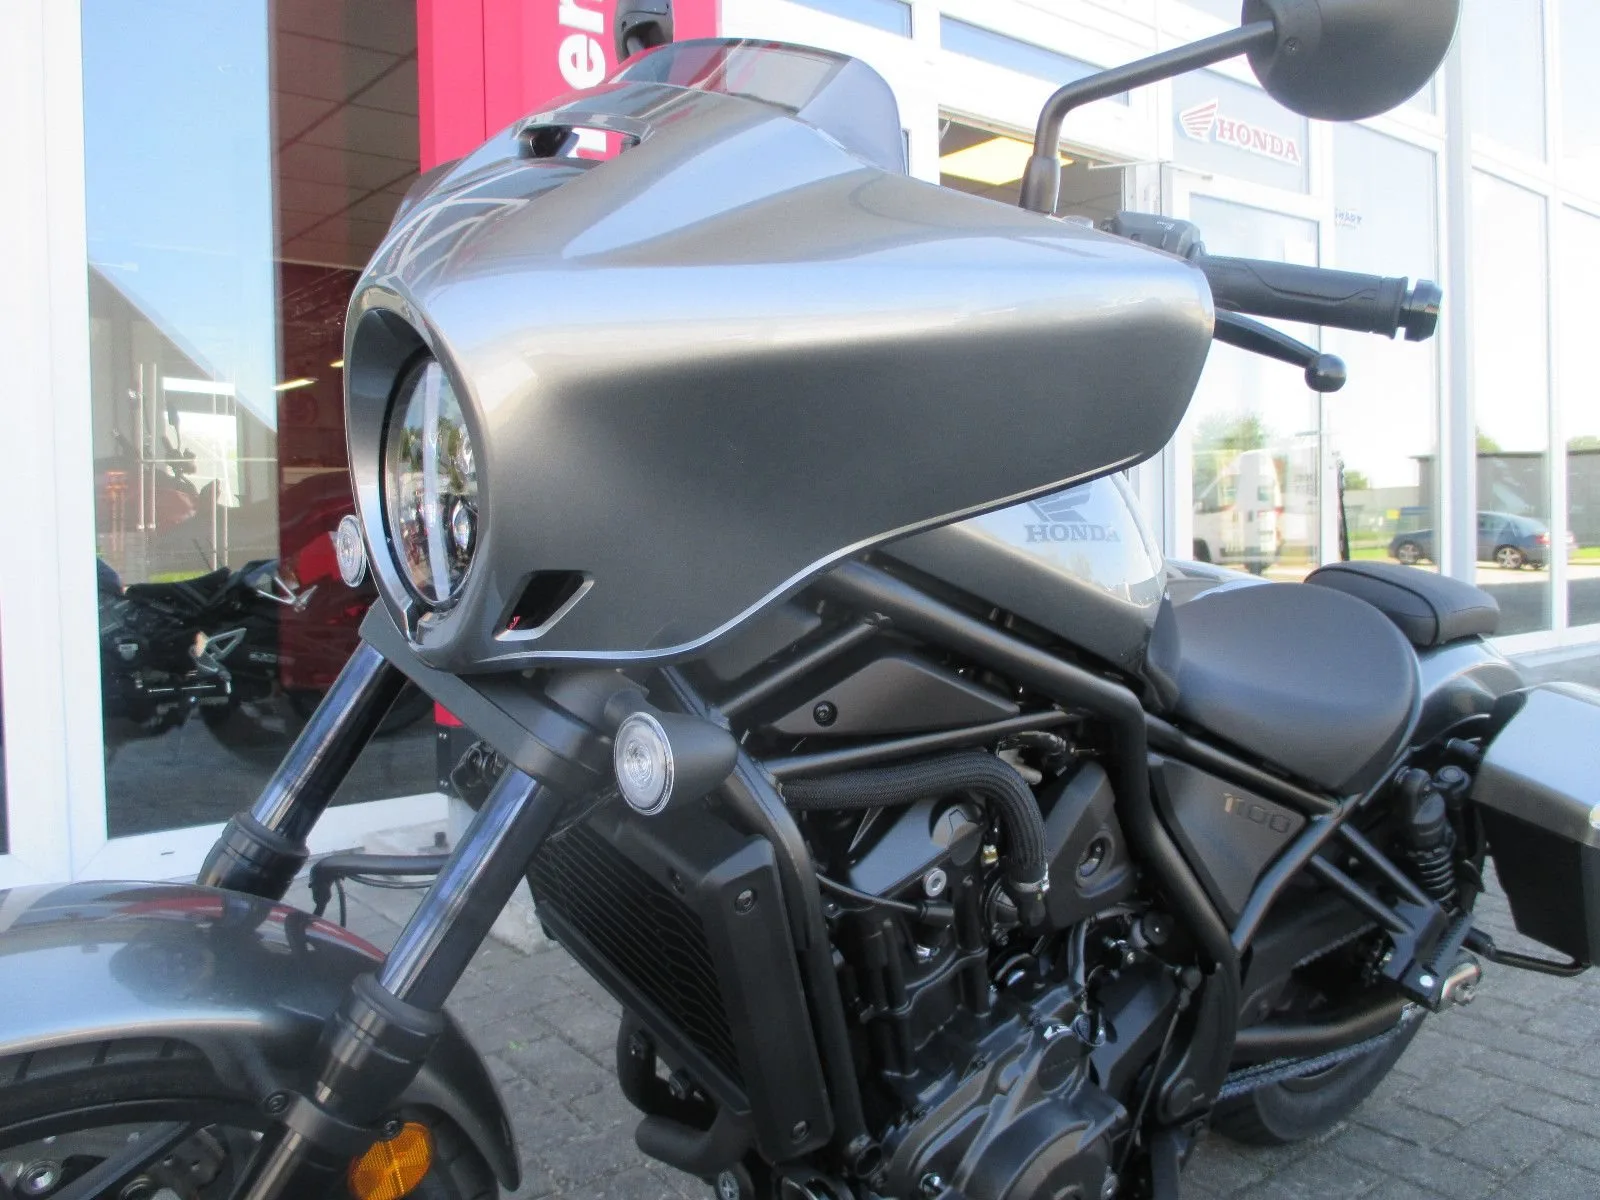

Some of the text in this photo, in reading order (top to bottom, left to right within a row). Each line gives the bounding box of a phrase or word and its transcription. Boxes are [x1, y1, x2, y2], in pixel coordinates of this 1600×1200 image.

[1217, 116, 1300, 162] HONDA
[1024, 524, 1121, 543] HONDA
[1222, 792, 1291, 834] 1100
